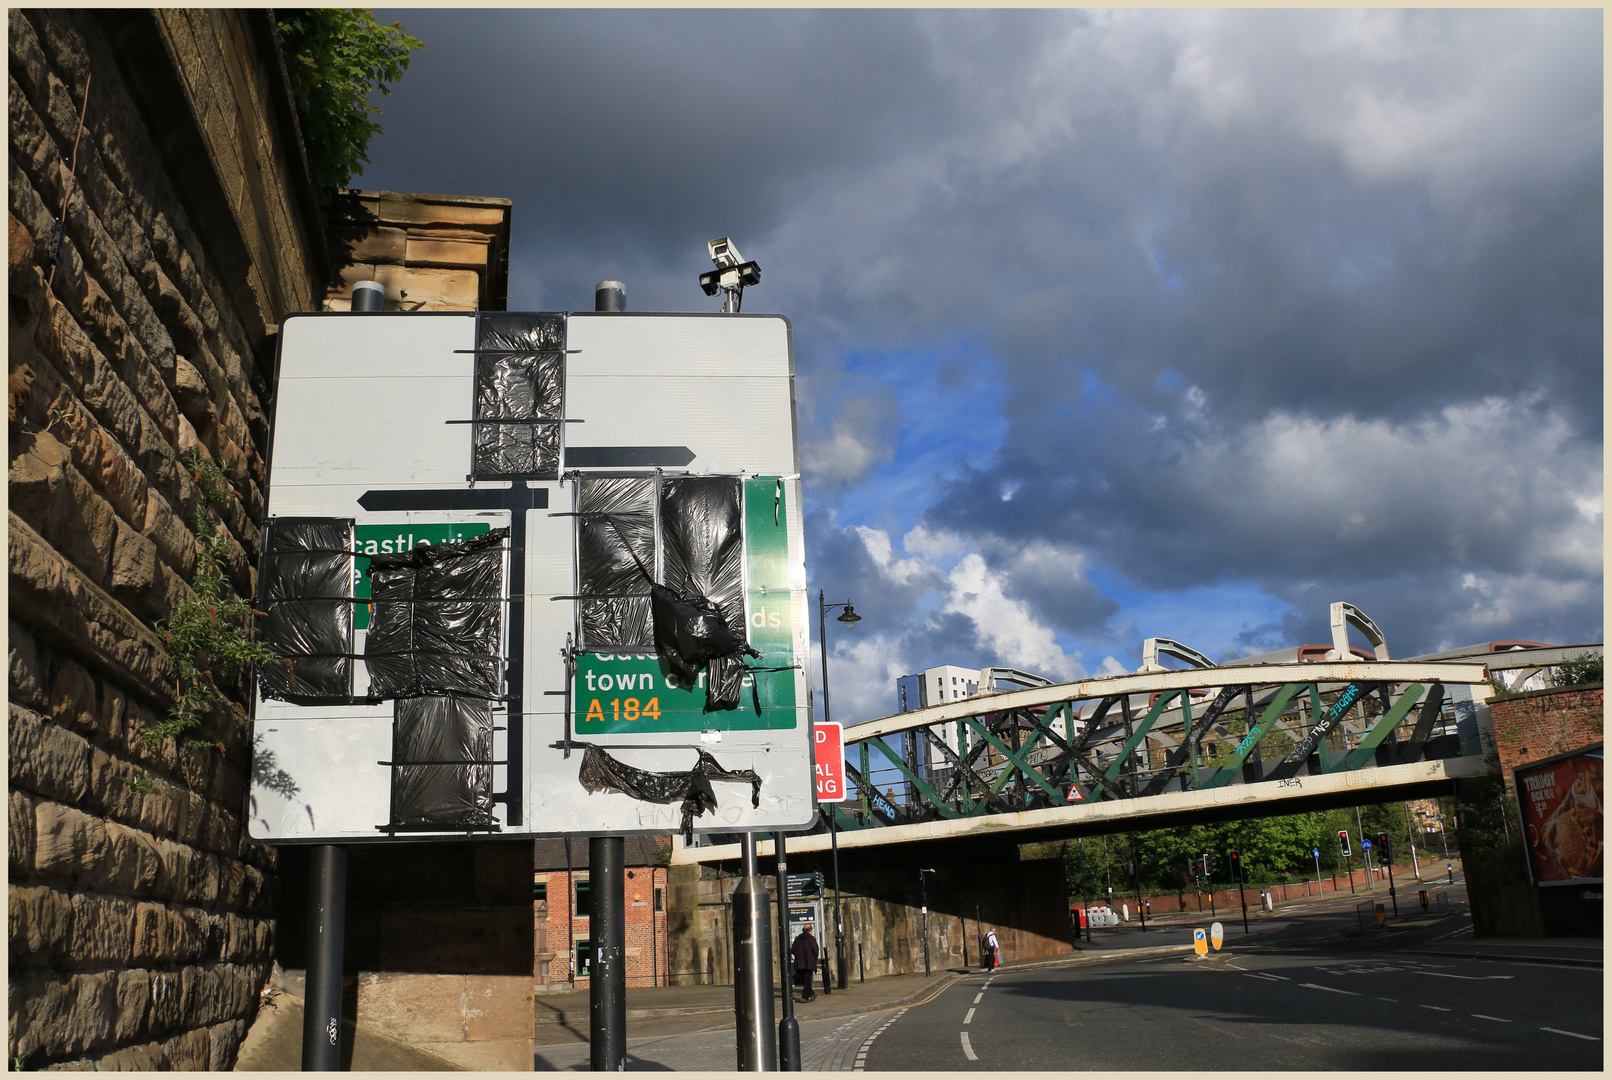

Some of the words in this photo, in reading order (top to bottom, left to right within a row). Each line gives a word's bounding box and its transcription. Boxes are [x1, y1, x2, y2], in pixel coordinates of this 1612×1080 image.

[584, 669, 654, 691] town
[1523, 771, 1556, 792] TRILOGY
[1530, 790, 1545, 803] BOX
